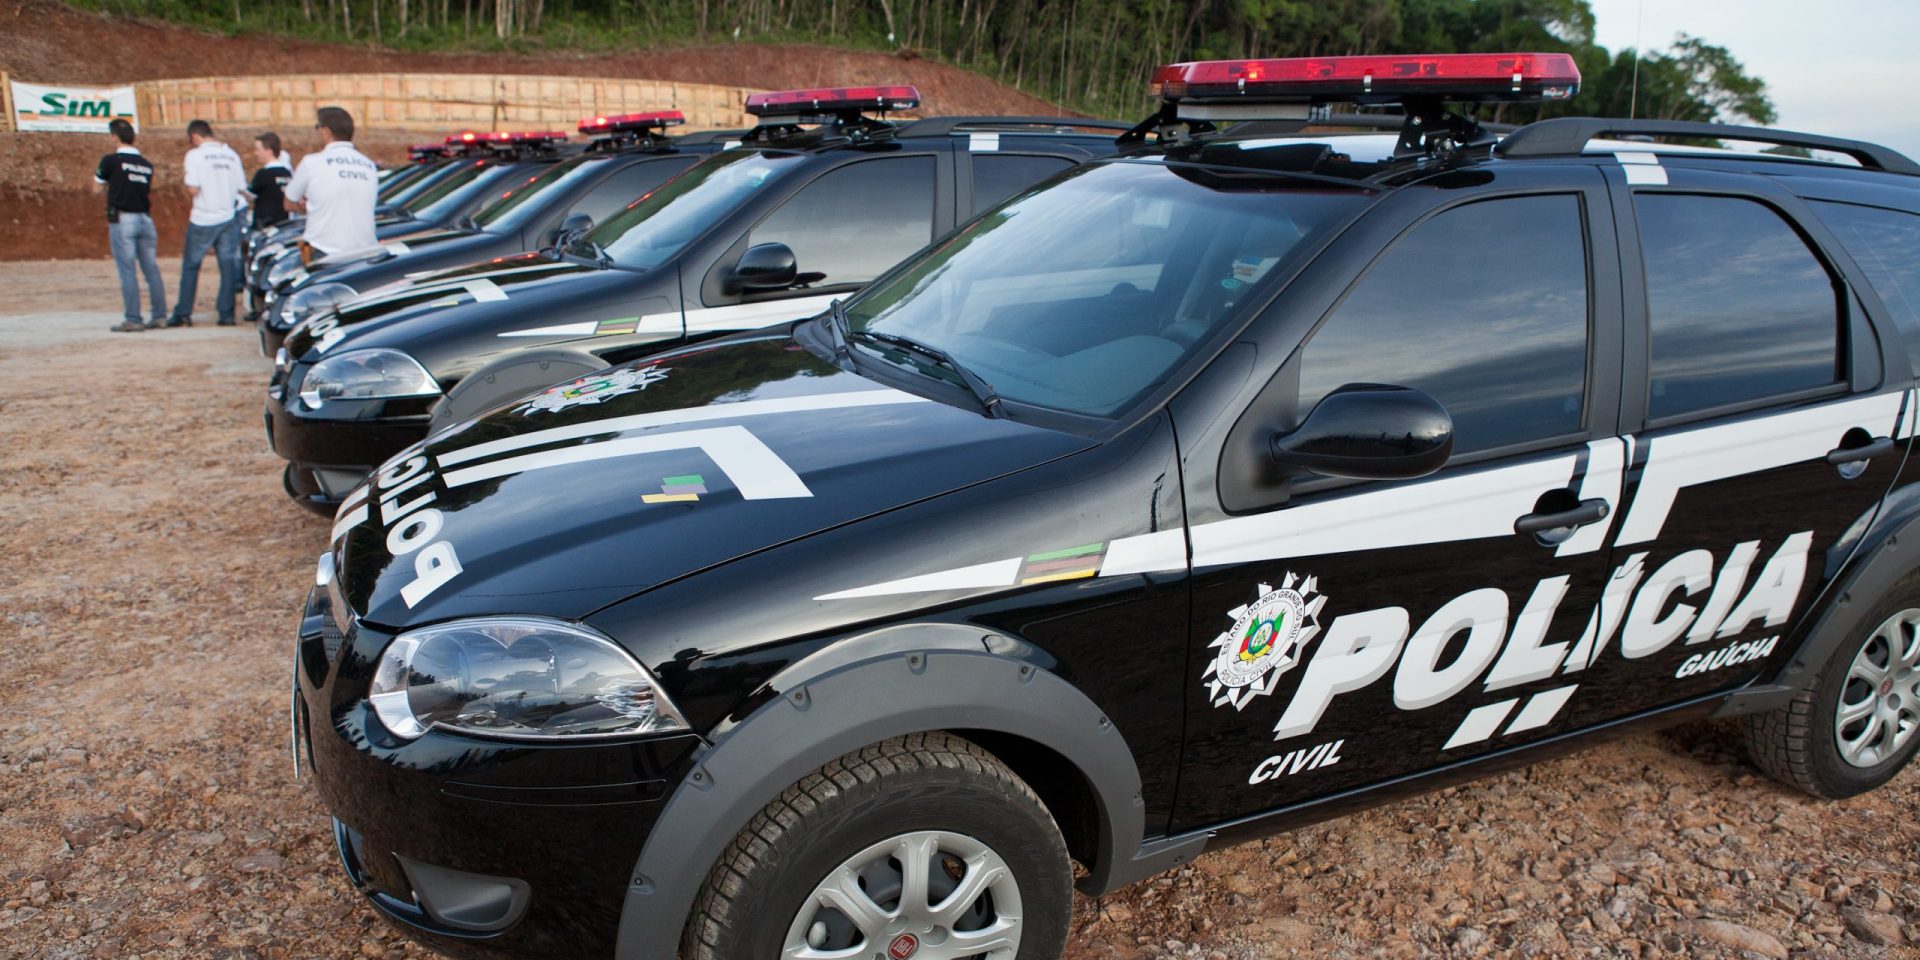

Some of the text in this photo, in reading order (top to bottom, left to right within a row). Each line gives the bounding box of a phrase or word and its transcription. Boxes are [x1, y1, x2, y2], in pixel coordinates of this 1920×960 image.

[40, 93, 111, 117] SIM
[339, 170, 368, 180] CIVIL
[1221, 591, 1304, 656] ESTADO DO RIO GRANDE DO SUL
[1274, 531, 1813, 741] POLÍCIA
[1250, 662, 1273, 681] CIVIL
[1676, 635, 1781, 679] GAÚCHA
[1248, 739, 1345, 785] CIVIL
